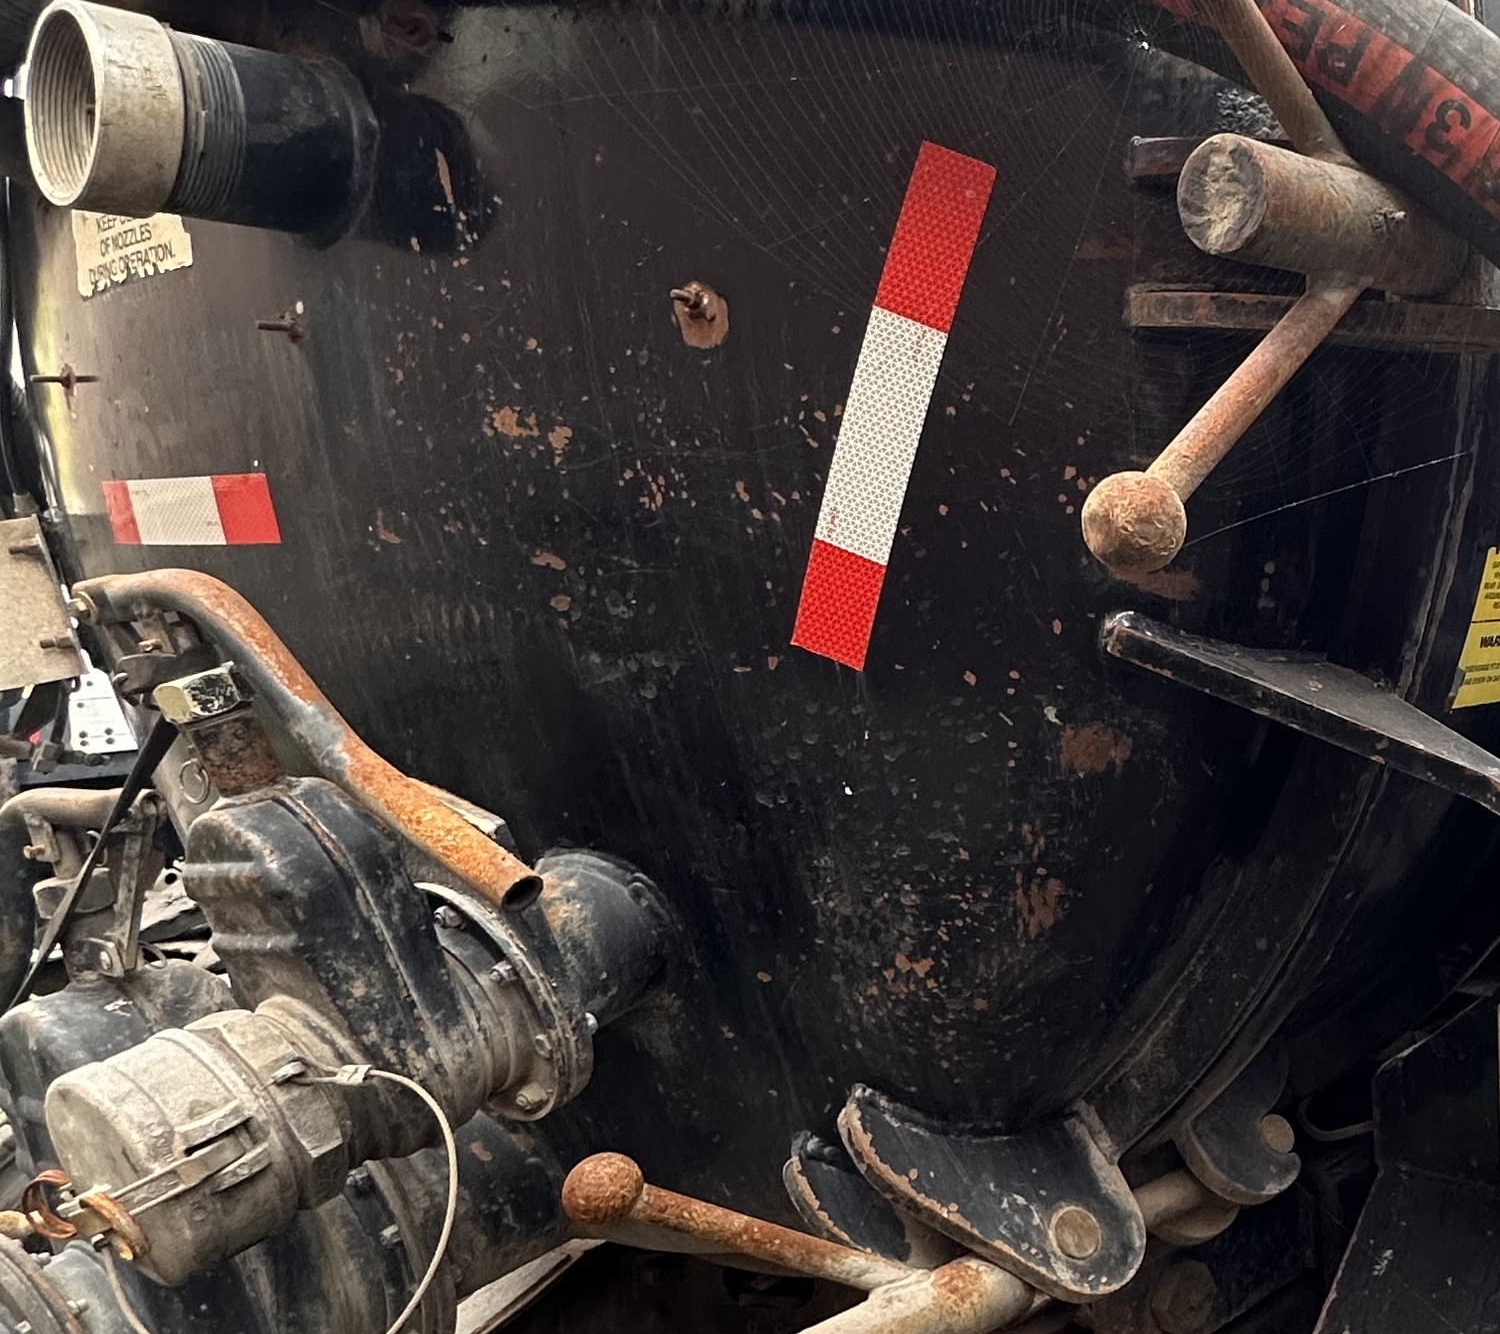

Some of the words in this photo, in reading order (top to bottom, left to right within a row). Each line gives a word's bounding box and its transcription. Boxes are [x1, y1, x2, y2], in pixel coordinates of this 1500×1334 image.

[100, 236, 111, 257] OF
[111, 222, 152, 252] NOZZLES
[88, 257, 118, 285] DURING
